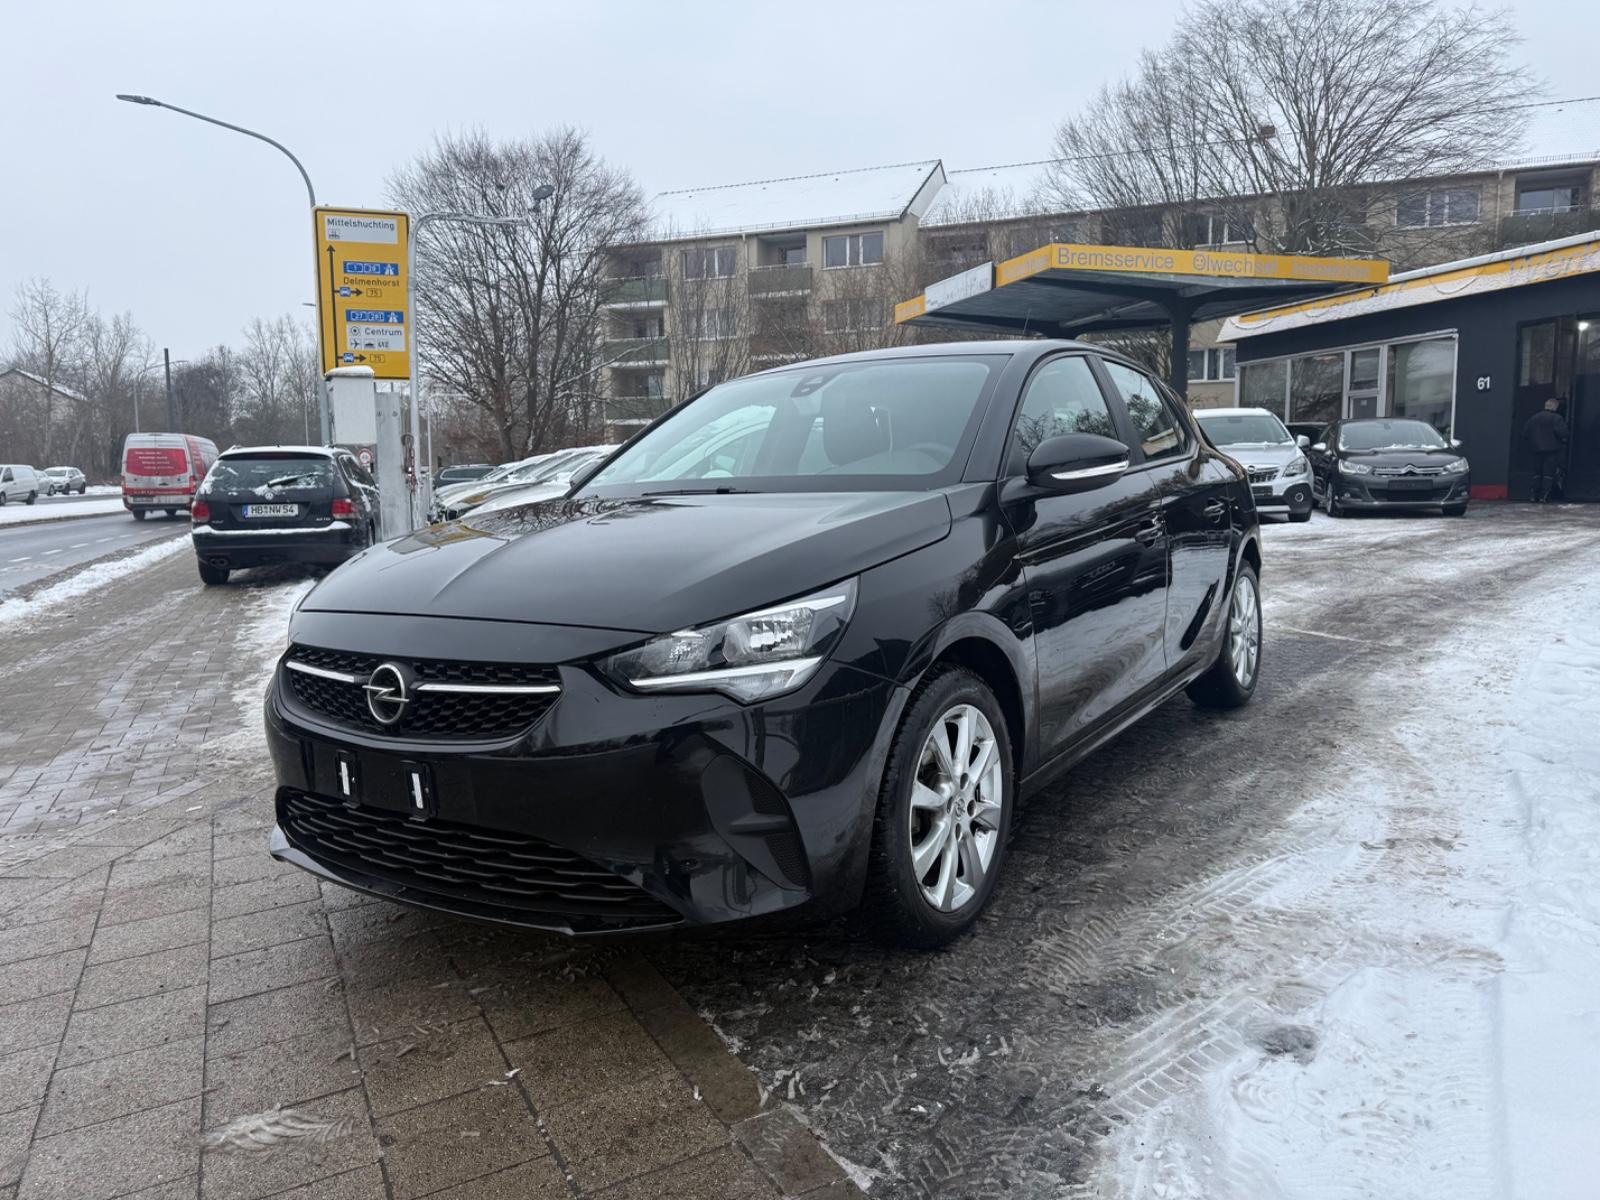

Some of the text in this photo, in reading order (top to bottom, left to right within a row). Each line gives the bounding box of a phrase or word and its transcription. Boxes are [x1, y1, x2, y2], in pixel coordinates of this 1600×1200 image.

[327, 218, 395, 231] Mittelshuchting
[1057, 247, 1174, 270] Bremsservice
[343, 276, 400, 287] Delmenhorst
[364, 327, 402, 337] Centrum
[1477, 376, 1490, 390] 61
[251, 504, 294, 515] HB NW 54
